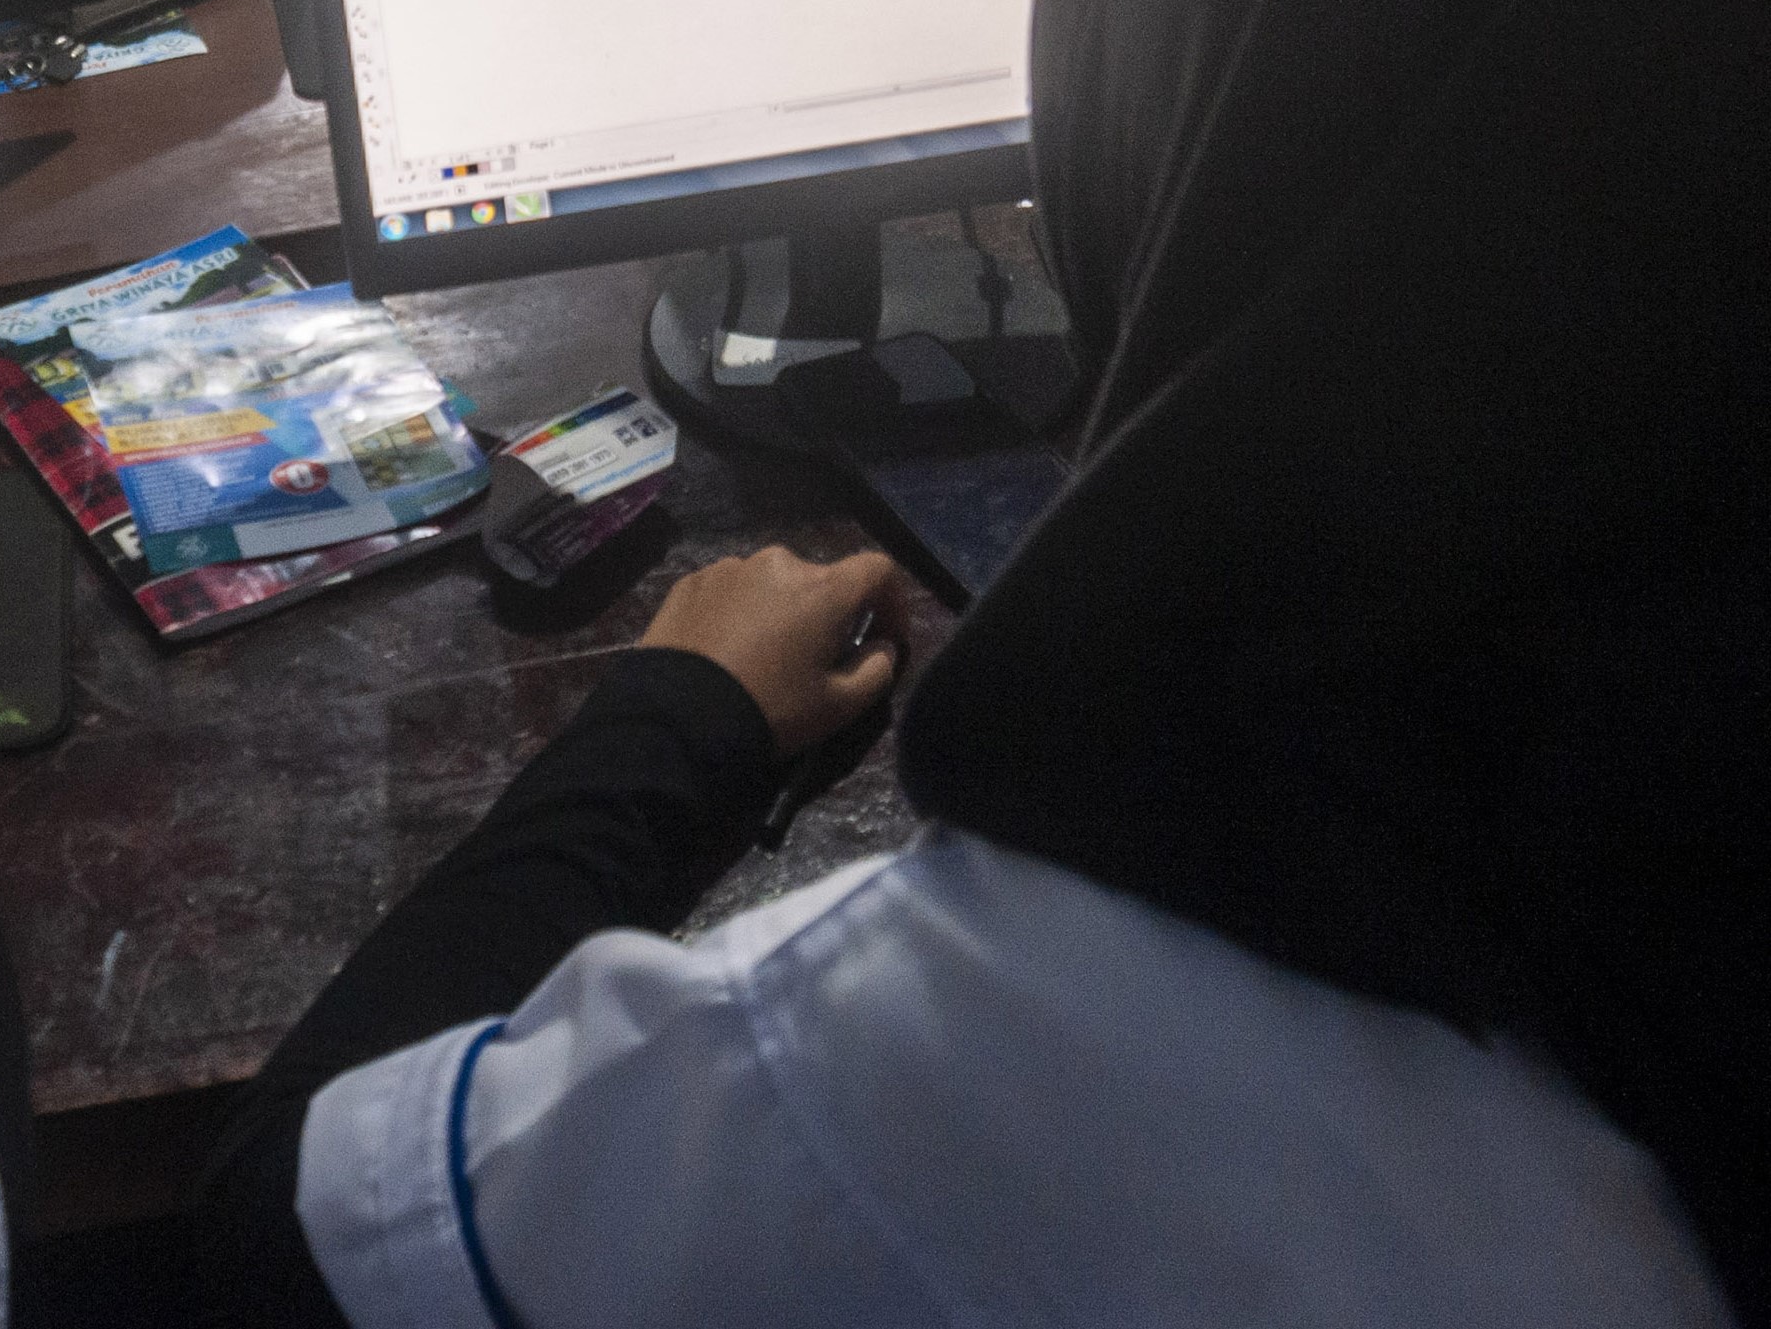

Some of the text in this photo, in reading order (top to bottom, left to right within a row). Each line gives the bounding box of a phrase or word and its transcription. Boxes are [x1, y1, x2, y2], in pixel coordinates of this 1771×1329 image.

[51, 297, 110, 323] GRIYA
[186, 246, 239, 275] ASRI
[89, 260, 179, 298] Perumahan
